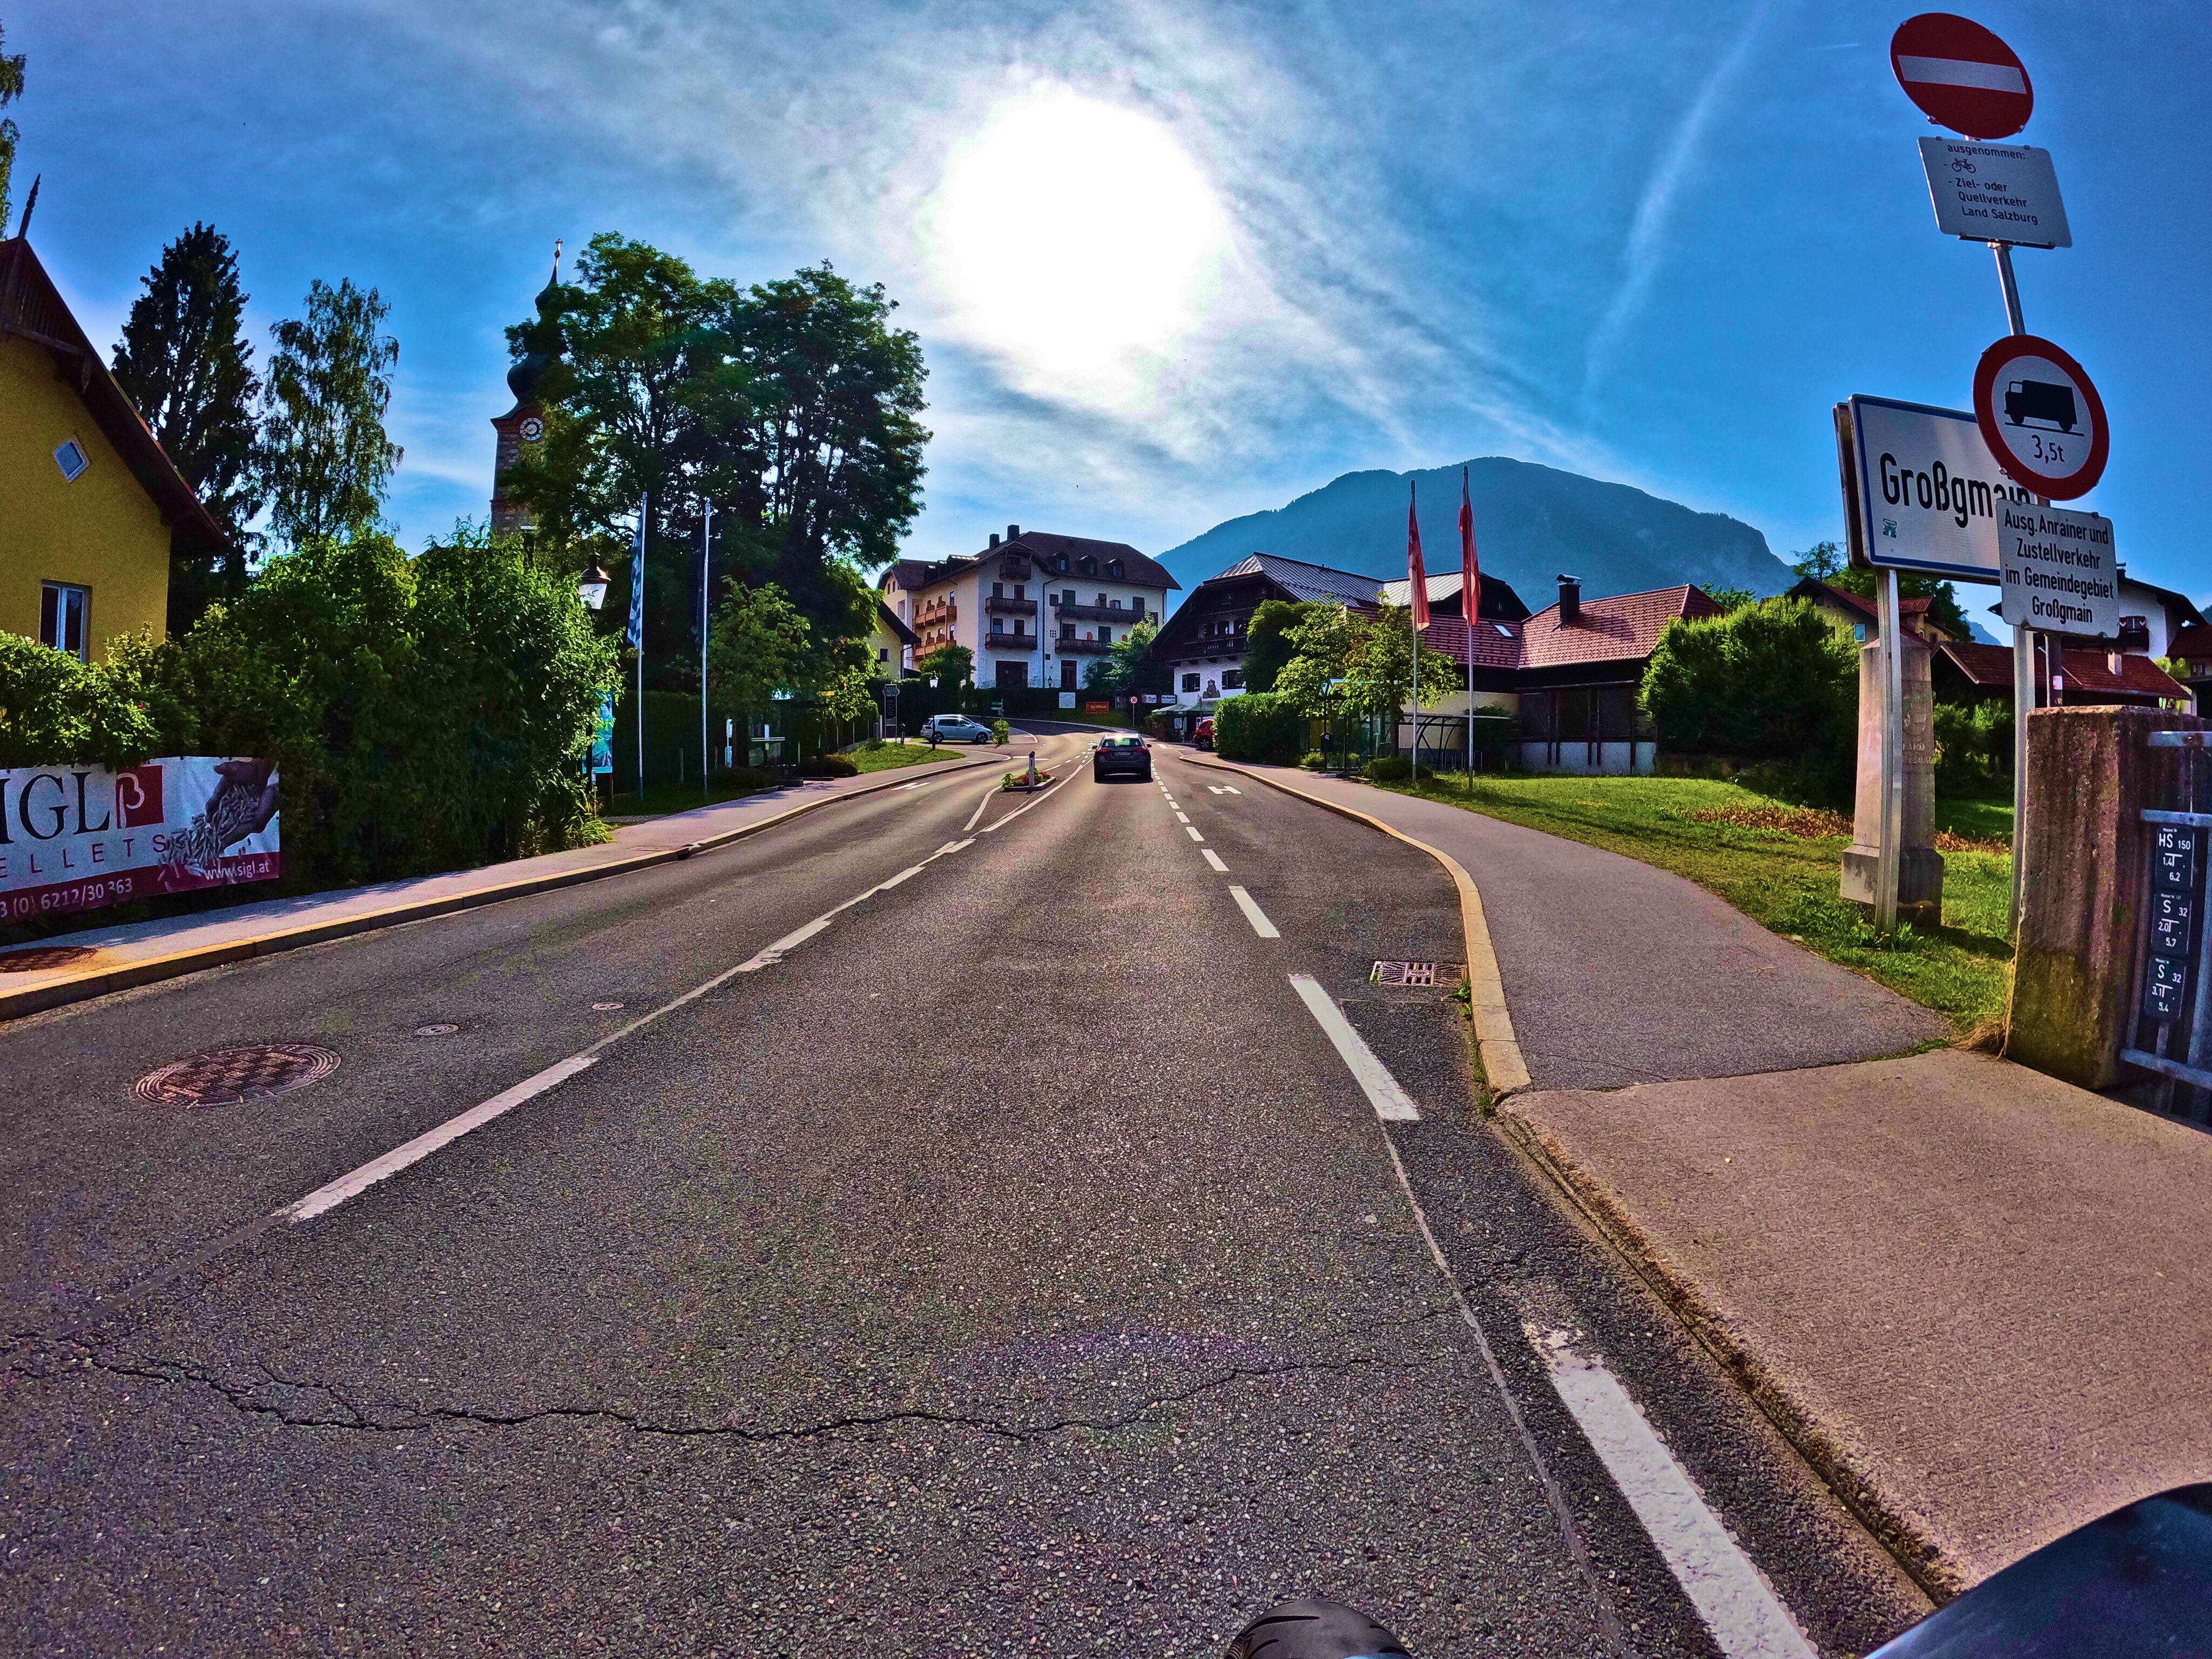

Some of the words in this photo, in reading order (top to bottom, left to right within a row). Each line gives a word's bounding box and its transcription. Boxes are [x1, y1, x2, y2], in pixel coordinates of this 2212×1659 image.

[1947, 145, 2025, 160] ausgenommen:
[1955, 177, 1980, 188] Ziel-
[1984, 181, 2007, 192] oder
[1958, 191, 2027, 207] Quellverkehr
[1961, 205, 1988, 218] Land
[1991, 208, 2038, 226] Salzburg
[2031, 434, 2065, 464] 3,5t
[1880, 452, 2031, 528] Großgm
[2005, 508, 2038, 536] Ausg.
[2039, 514, 2088, 540] Anrainer
[2089, 526, 2109, 545] und
[2017, 537, 2101, 570] Zustellverkehr
[2005, 563, 2020, 585] im
[2025, 567, 2114, 600] Gemeindegebiet
[2032, 595, 2093, 624] Großgmain
[2159, 833, 2174, 848] HS
[2178, 840, 2191, 850] 150
[2163, 900, 2171, 913] S
[2179, 907, 2188, 917] 32
[2157, 964, 2165, 979] S
[2172, 973, 2182, 983] 32
